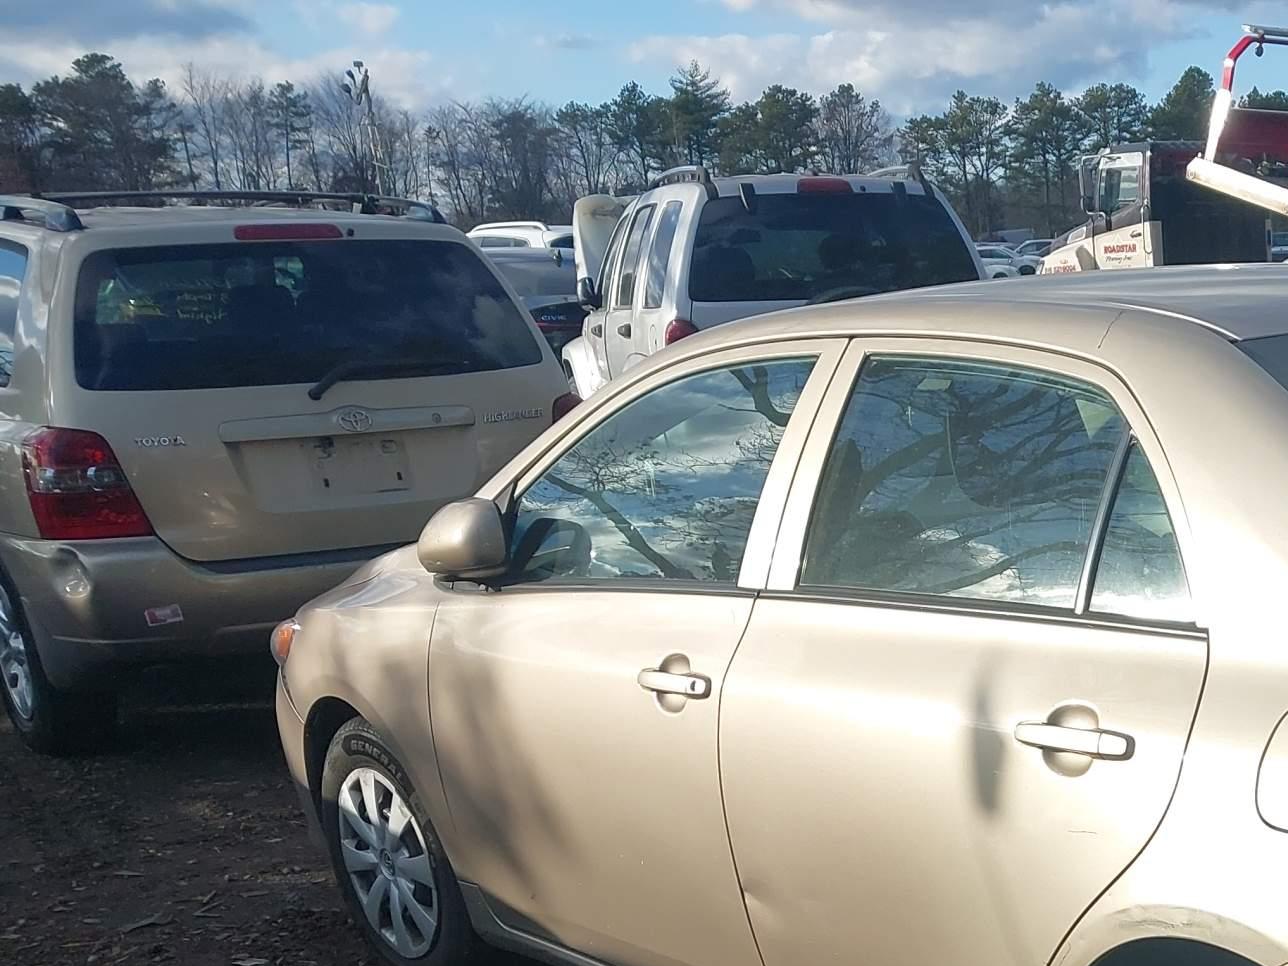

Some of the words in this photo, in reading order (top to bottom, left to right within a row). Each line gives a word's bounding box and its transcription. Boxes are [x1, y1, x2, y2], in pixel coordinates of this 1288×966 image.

[1104, 244, 1136, 254] ROADSTAR
[134, 436, 185, 446] TOYOTA
[350, 739, 403, 780] GENERAL
